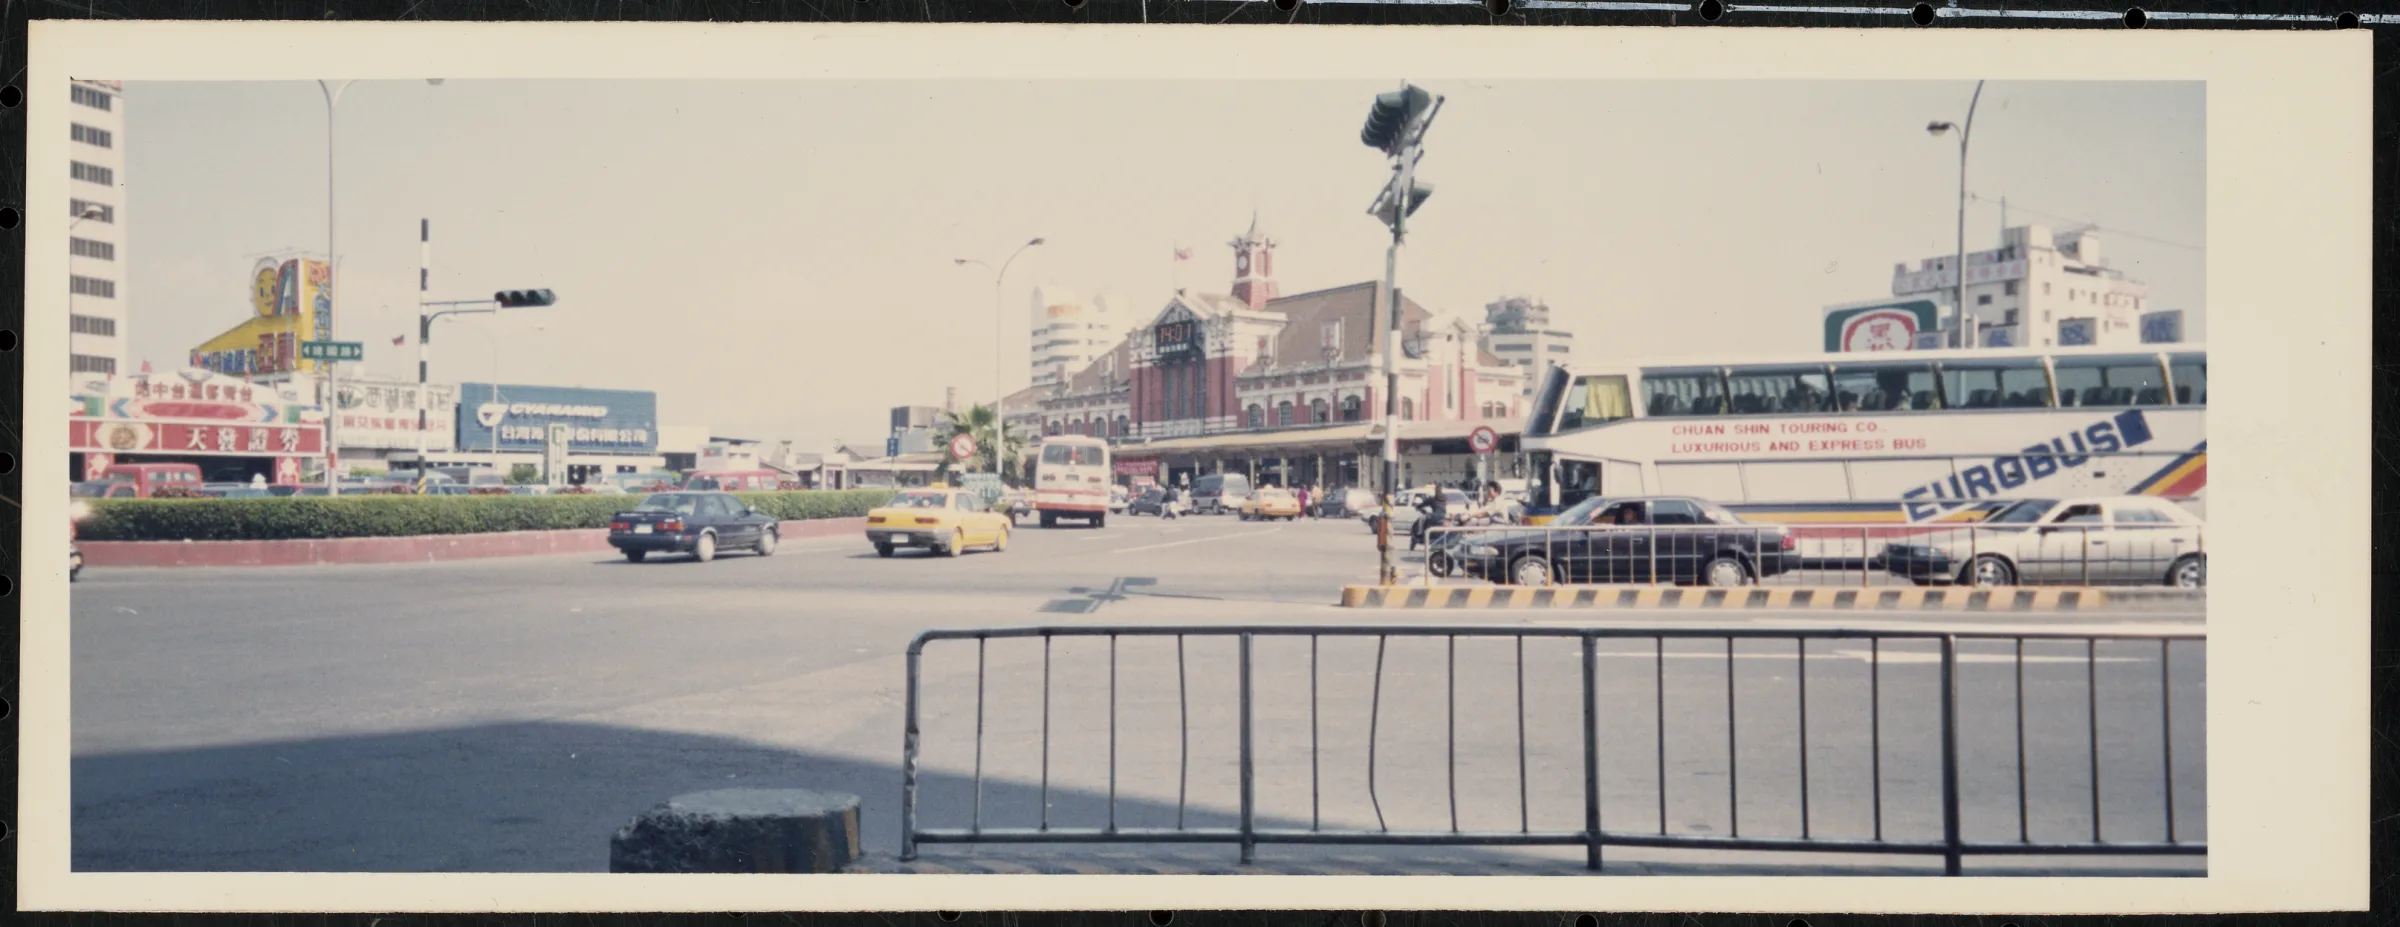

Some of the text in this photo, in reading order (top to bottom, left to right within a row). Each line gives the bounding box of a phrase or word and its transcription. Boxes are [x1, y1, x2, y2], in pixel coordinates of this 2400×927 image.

[1672, 424, 1725, 436] CHUAN
[1734, 423, 1770, 435] SHIN
[1780, 422, 1848, 434] TOURING
[1671, 438, 1927, 454] LUXURIOUS AND EXPRESS BUS
[1903, 421, 2121, 522] EUROBUS
